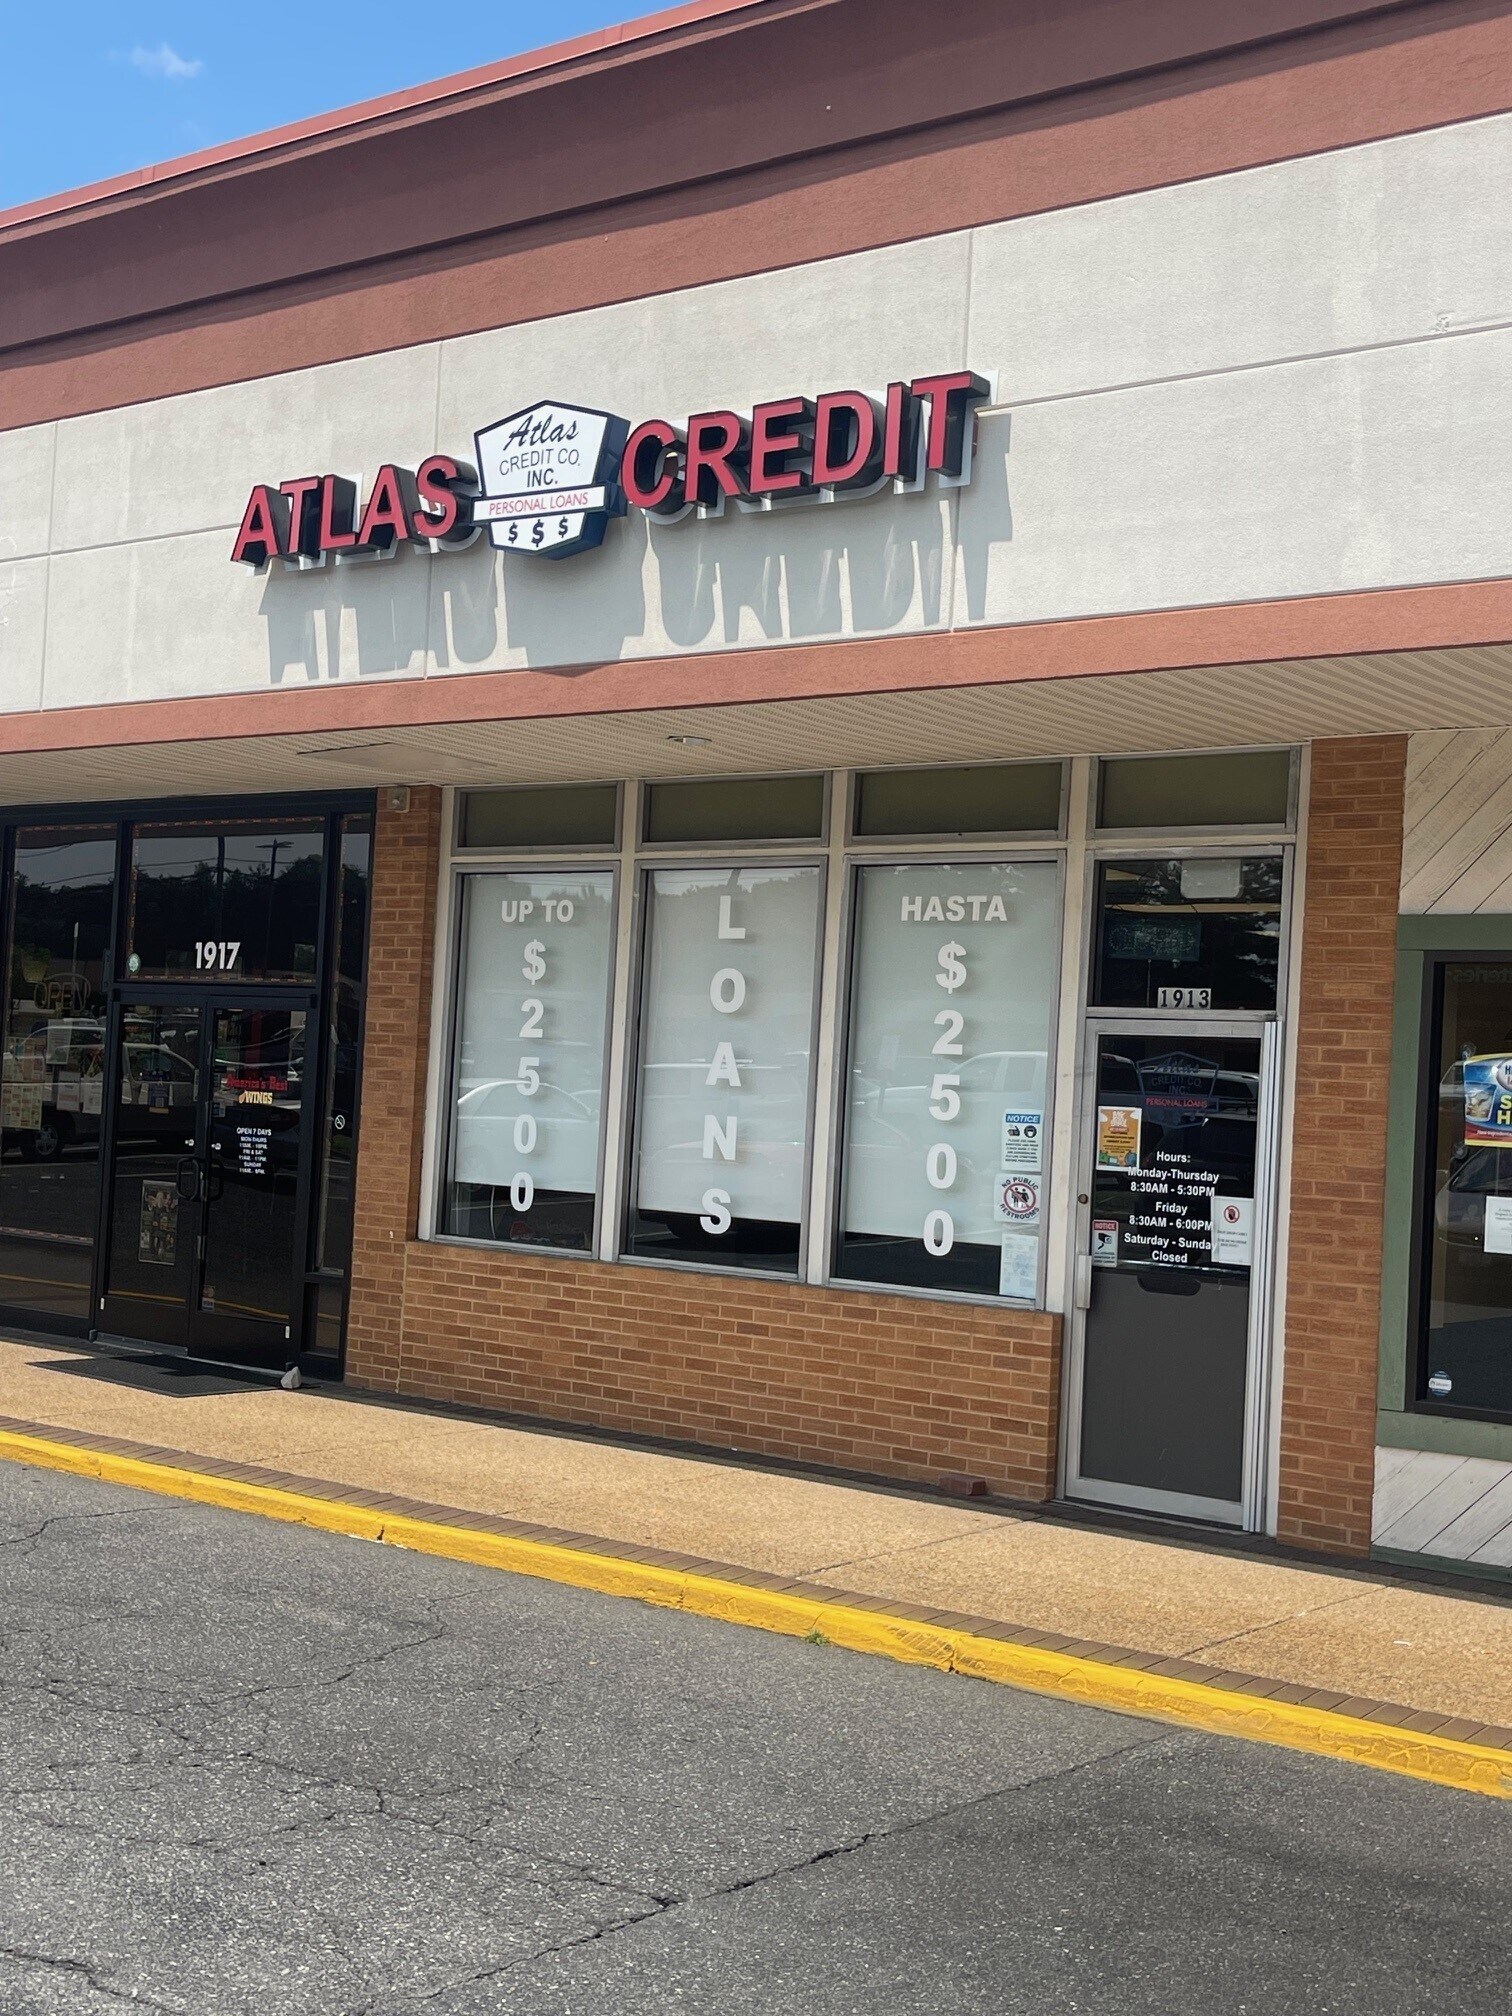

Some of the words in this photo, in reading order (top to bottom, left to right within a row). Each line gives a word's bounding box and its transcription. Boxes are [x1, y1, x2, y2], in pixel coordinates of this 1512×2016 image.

[503, 414, 580, 450] Atlas
[230, 454, 460, 563] ATLAS
[620, 370, 974, 509] CREDIT
[499, 449, 555, 476] CREDIT
[557, 448, 581, 466] CO.
[526, 468, 558, 488] INC.
[488, 498, 547, 516] PERSONAL
[549, 492, 589, 508] LOANS
[500, 901, 535, 923] UP
[540, 899, 574, 923] TO
[901, 895, 1008, 922] HASTA
[195, 941, 241, 970] 1917
[1161, 989, 1209, 1008] 1913
[244, 1091, 273, 1105] WINGS
[1145, 1097, 1182, 1108] PERSONAL
[1183, 1100, 1208, 1109] LOANS
[1006, 1115, 1039, 1123] NOTICE
[257, 1128, 271, 1136] DAYS
[1156, 1151, 1191, 1163] Hours:
[1128, 1166, 1219, 1184] Monday-Thursday
[1001, 1179, 1011, 1188] NO
[1013, 1176, 1039, 1191] PUBLIC
[1130, 1181, 1168, 1194] 8:30AM
[1177, 1185, 1215, 1197] 5:30PM
[999, 1203, 1040, 1220] RESTROOMS
[1155, 1201, 1188, 1216] Friday
[1094, 1222, 1116, 1230] NOTICE
[1129, 1215, 1167, 1228] 8:30AM
[1175, 1219, 1214, 1231] 6:00PM
[1124, 1232, 1169, 1248] Saturday
[1151, 1249, 1188, 1263] Closed
